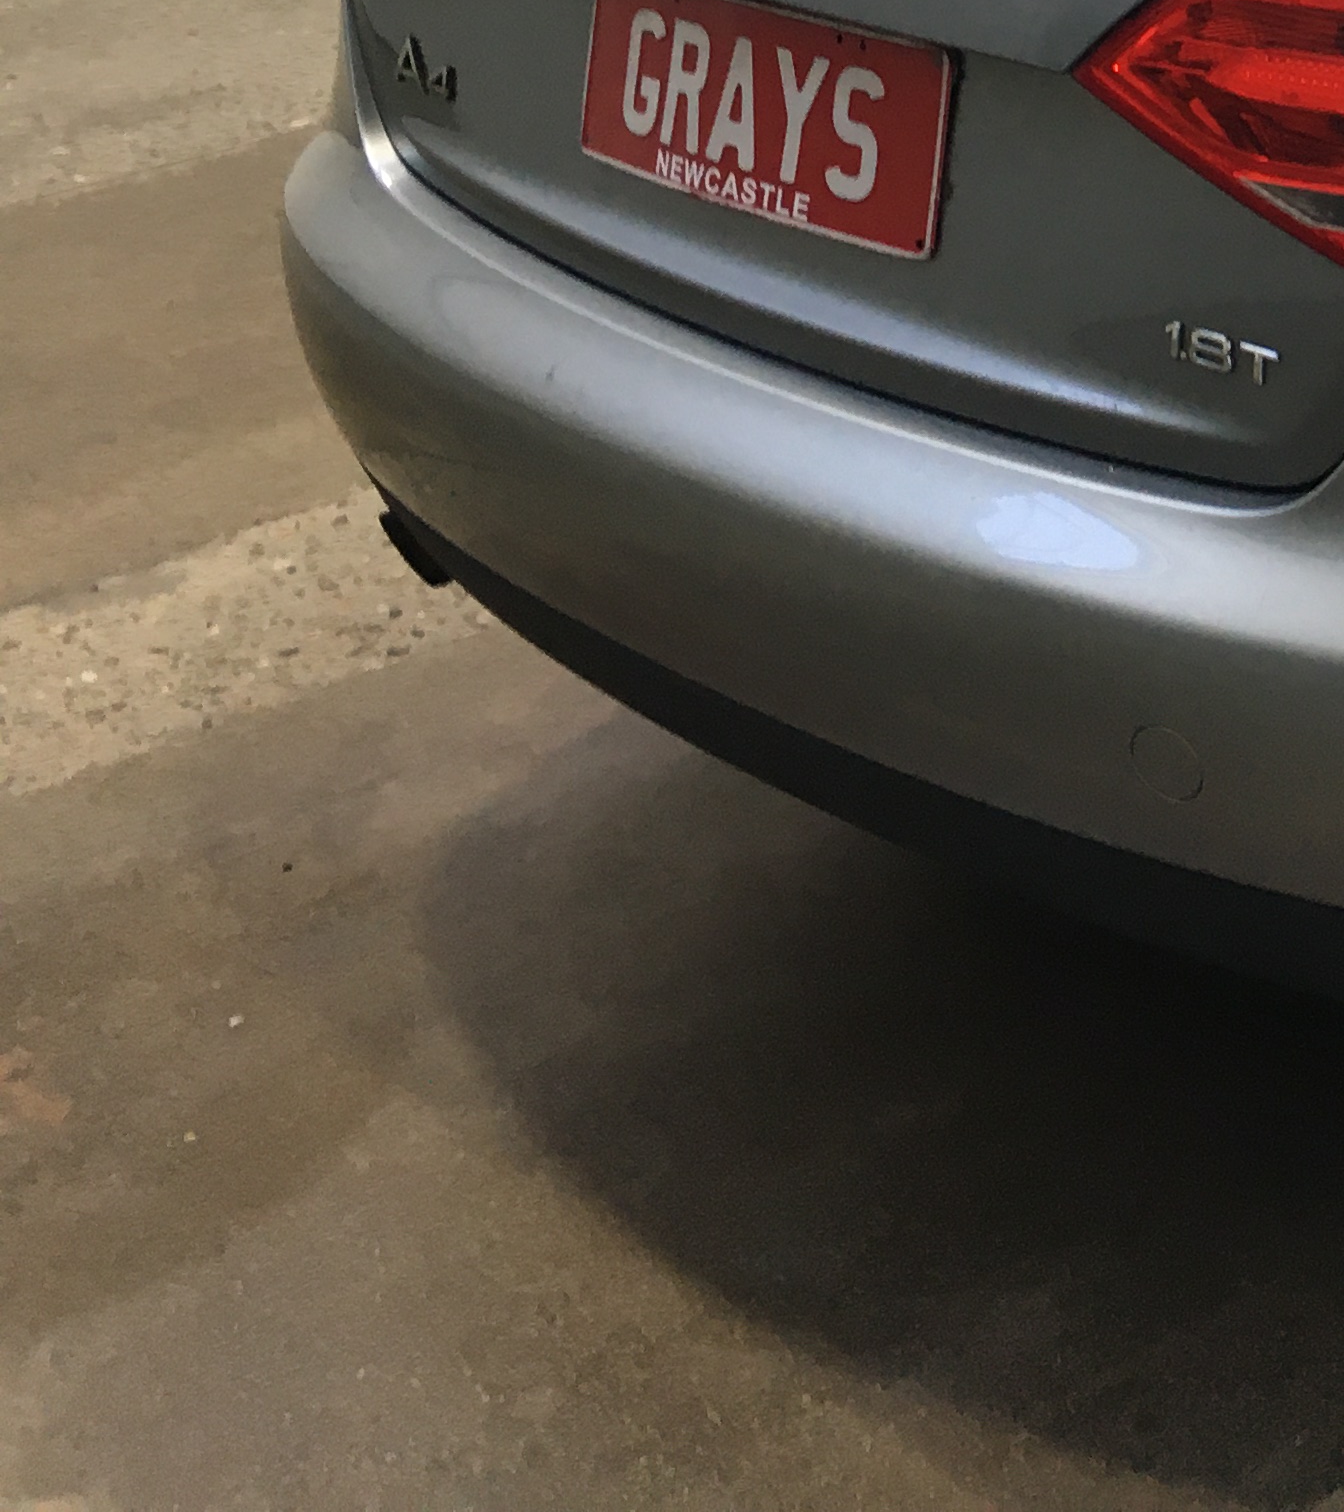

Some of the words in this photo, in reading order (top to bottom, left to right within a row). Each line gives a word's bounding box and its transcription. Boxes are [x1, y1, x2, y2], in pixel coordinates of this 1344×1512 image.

[396, 34, 457, 103] A4
[622, 8, 885, 203] GRAYS
[655, 148, 810, 222] NEWCASTLE
